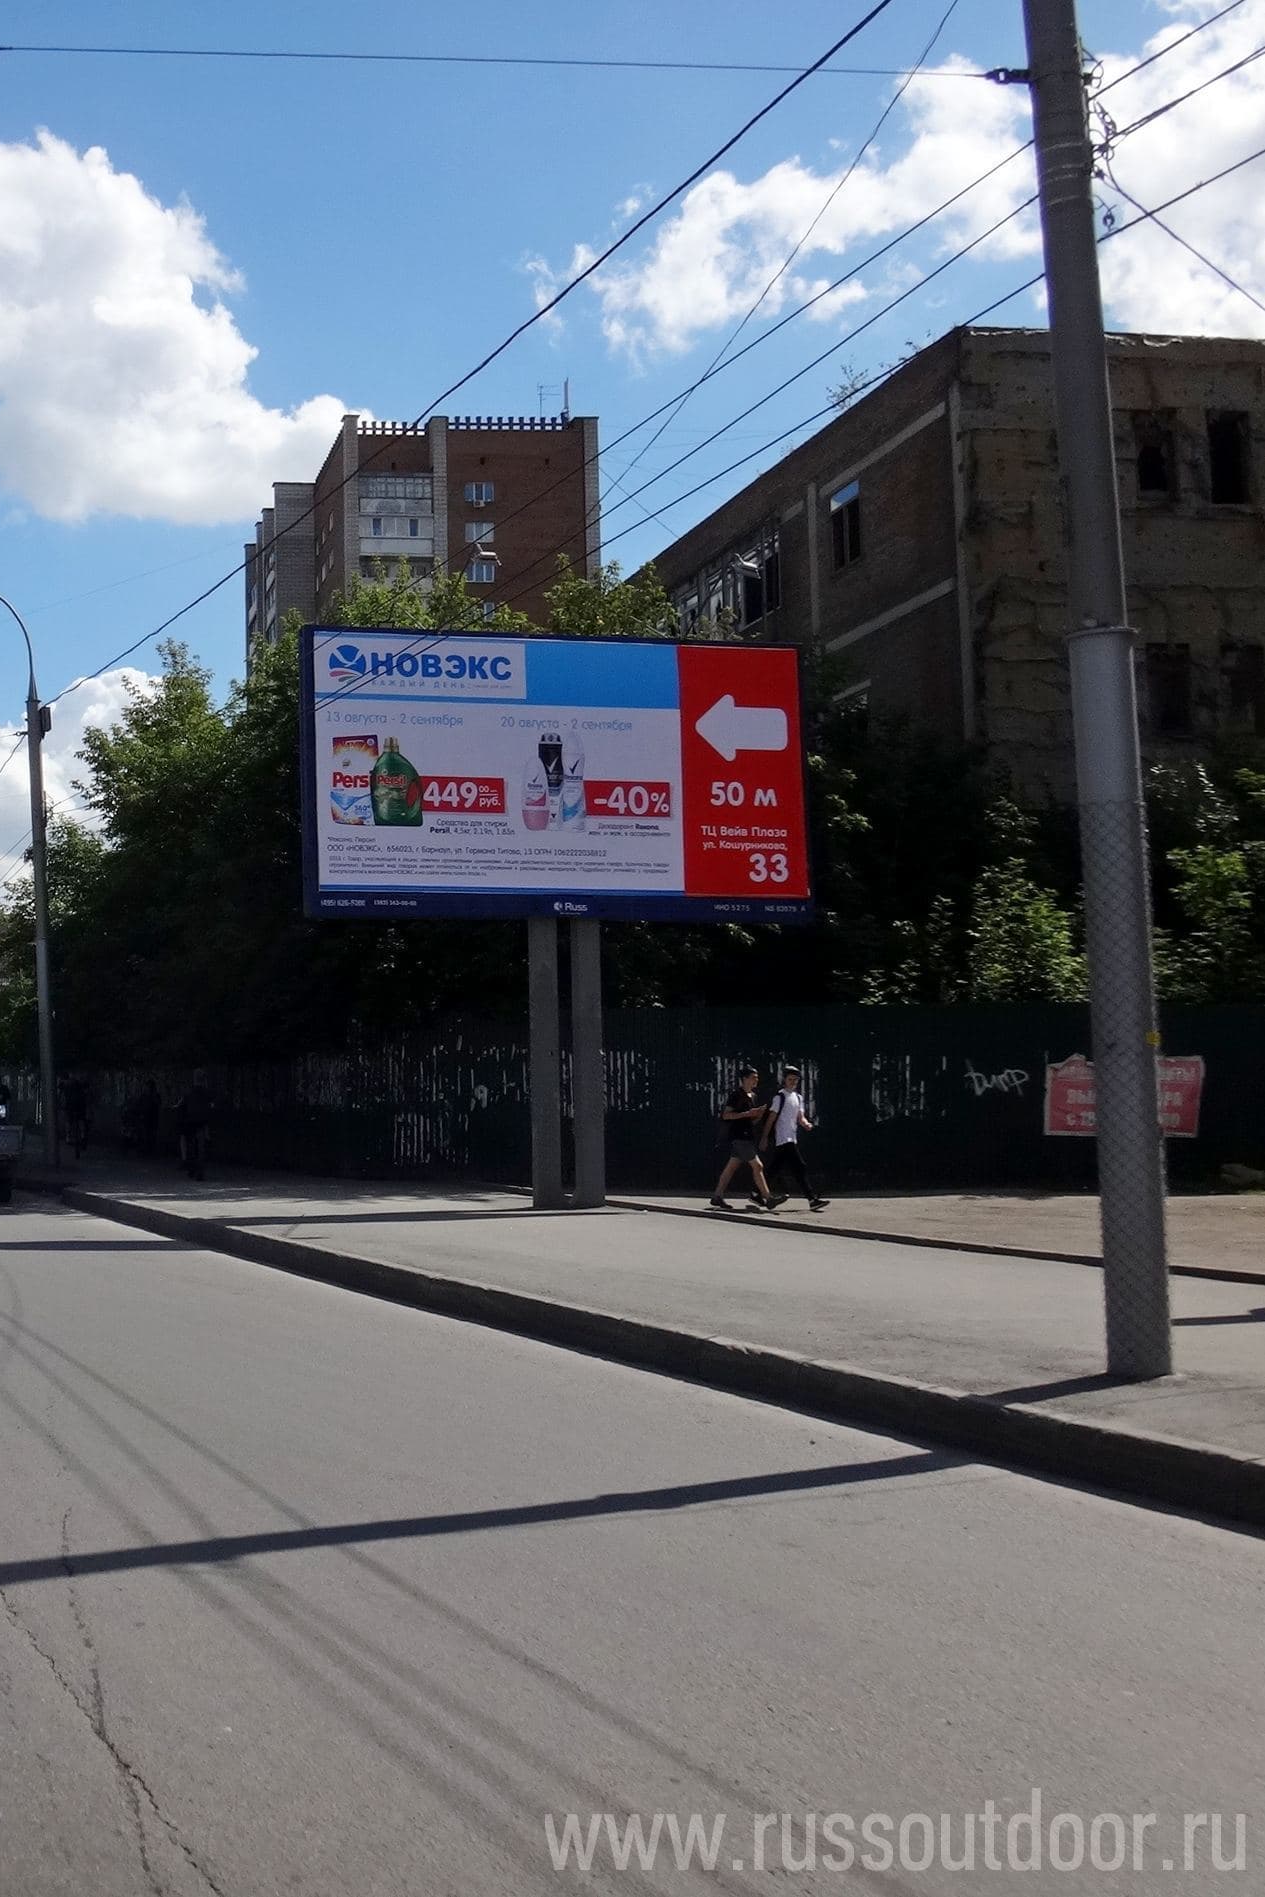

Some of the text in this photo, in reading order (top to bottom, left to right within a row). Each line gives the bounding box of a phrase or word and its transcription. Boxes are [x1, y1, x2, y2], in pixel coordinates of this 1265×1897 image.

[371, 652, 512, 681] НОВЭКС
[344, 714, 387, 726] августа
[400, 713, 407, 724] 2
[410, 713, 464, 729] сентября
[500, 716, 515, 728] 20
[518, 719, 560, 731] августа
[571, 719, 578, 730] 2
[581, 719, 633, 732] сентября
[332, 772, 369, 788] Pers
[377, 775, 407, 785] Persil
[422, 781, 478, 808] 449
[479, 796, 501, 808] руб.
[593, 785, 670, 815] -40%
[710, 781, 778, 807] 50 м
[700, 825, 787, 838] ТЦ Вейв Плаза
[326, 844, 344, 852] ООО
[749, 853, 789, 883] 33
[564, 902, 588, 912] Russ
